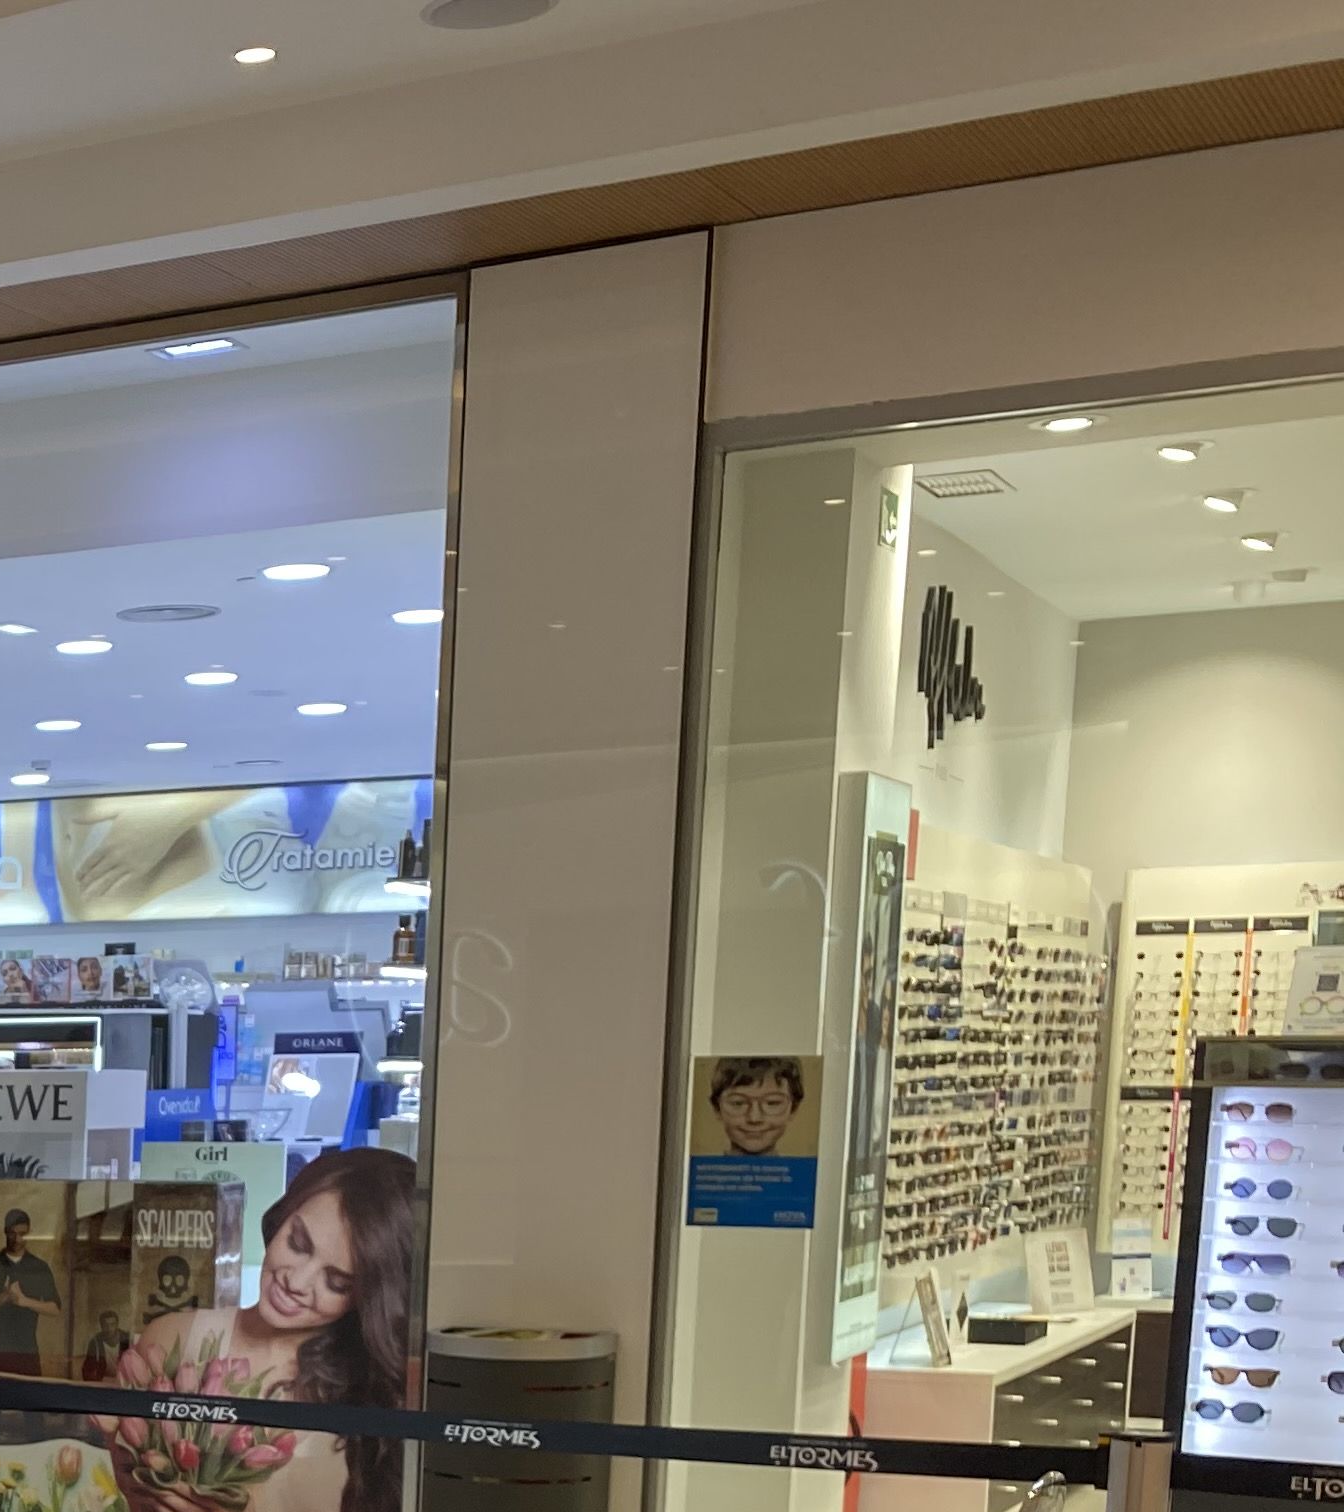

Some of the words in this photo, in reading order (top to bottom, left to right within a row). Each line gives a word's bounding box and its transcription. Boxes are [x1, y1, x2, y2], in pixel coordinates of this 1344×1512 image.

[292, 1037, 344, 1049] ORLANE
[195, 1146, 229, 1162] Girl
[137, 1208, 216, 1250] SCALPERS
